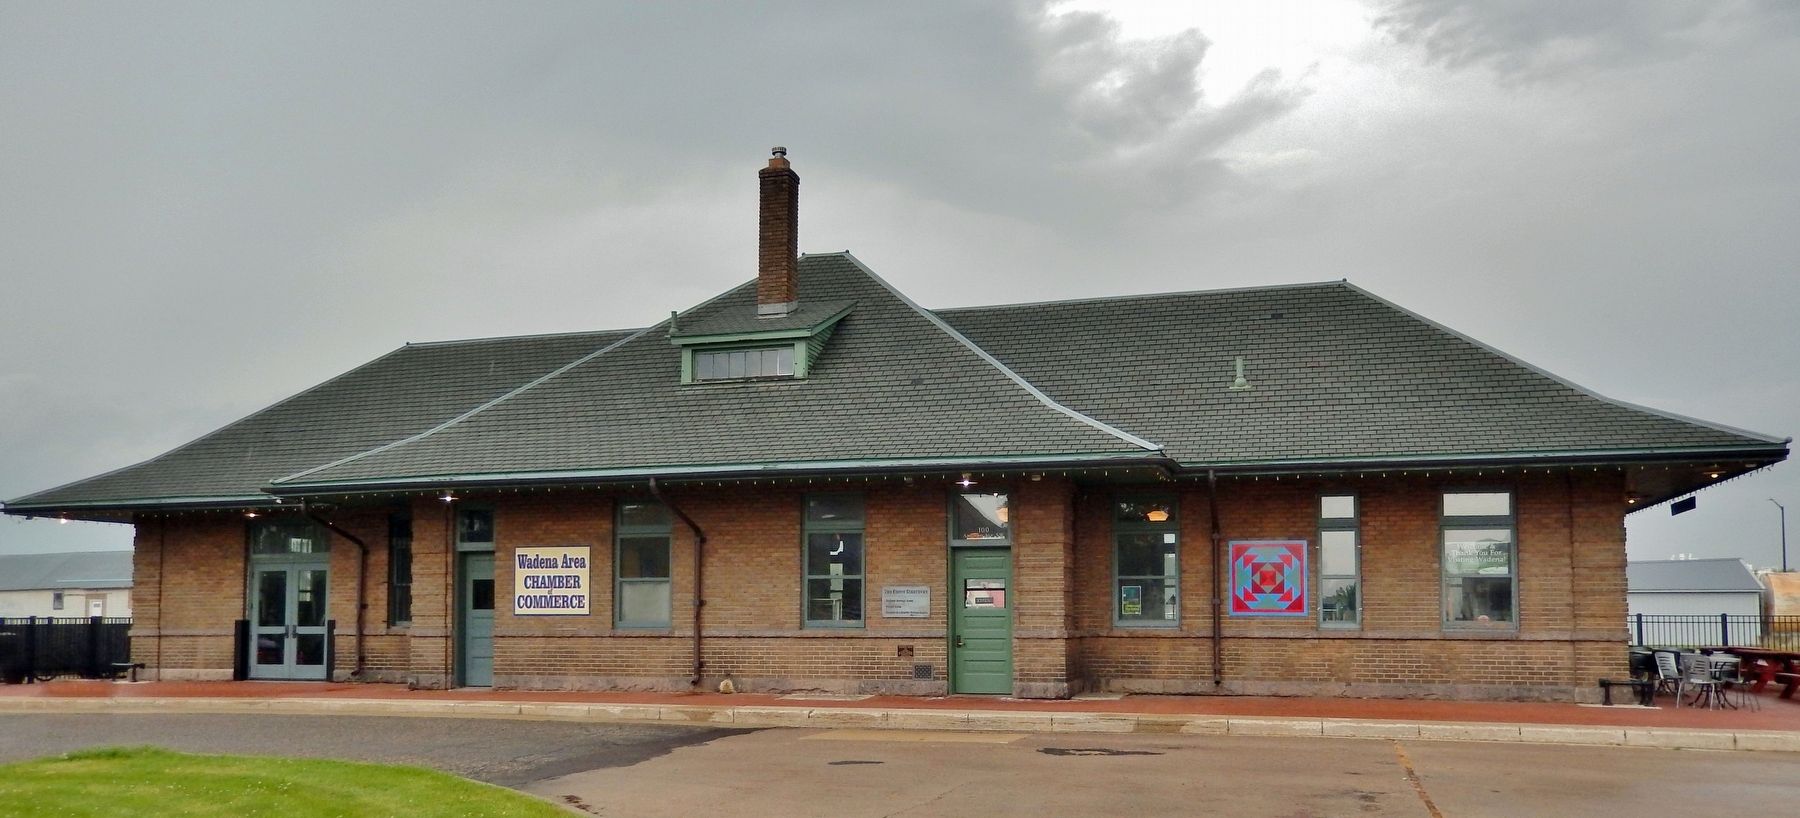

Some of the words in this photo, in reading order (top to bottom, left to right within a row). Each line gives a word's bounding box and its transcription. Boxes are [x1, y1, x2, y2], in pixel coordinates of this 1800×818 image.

[517, 554, 559, 569] Wadena
[561, 553, 586, 568] Area
[524, 575, 581, 589] CHAMBER
[517, 595, 585, 609] COMMERCE
